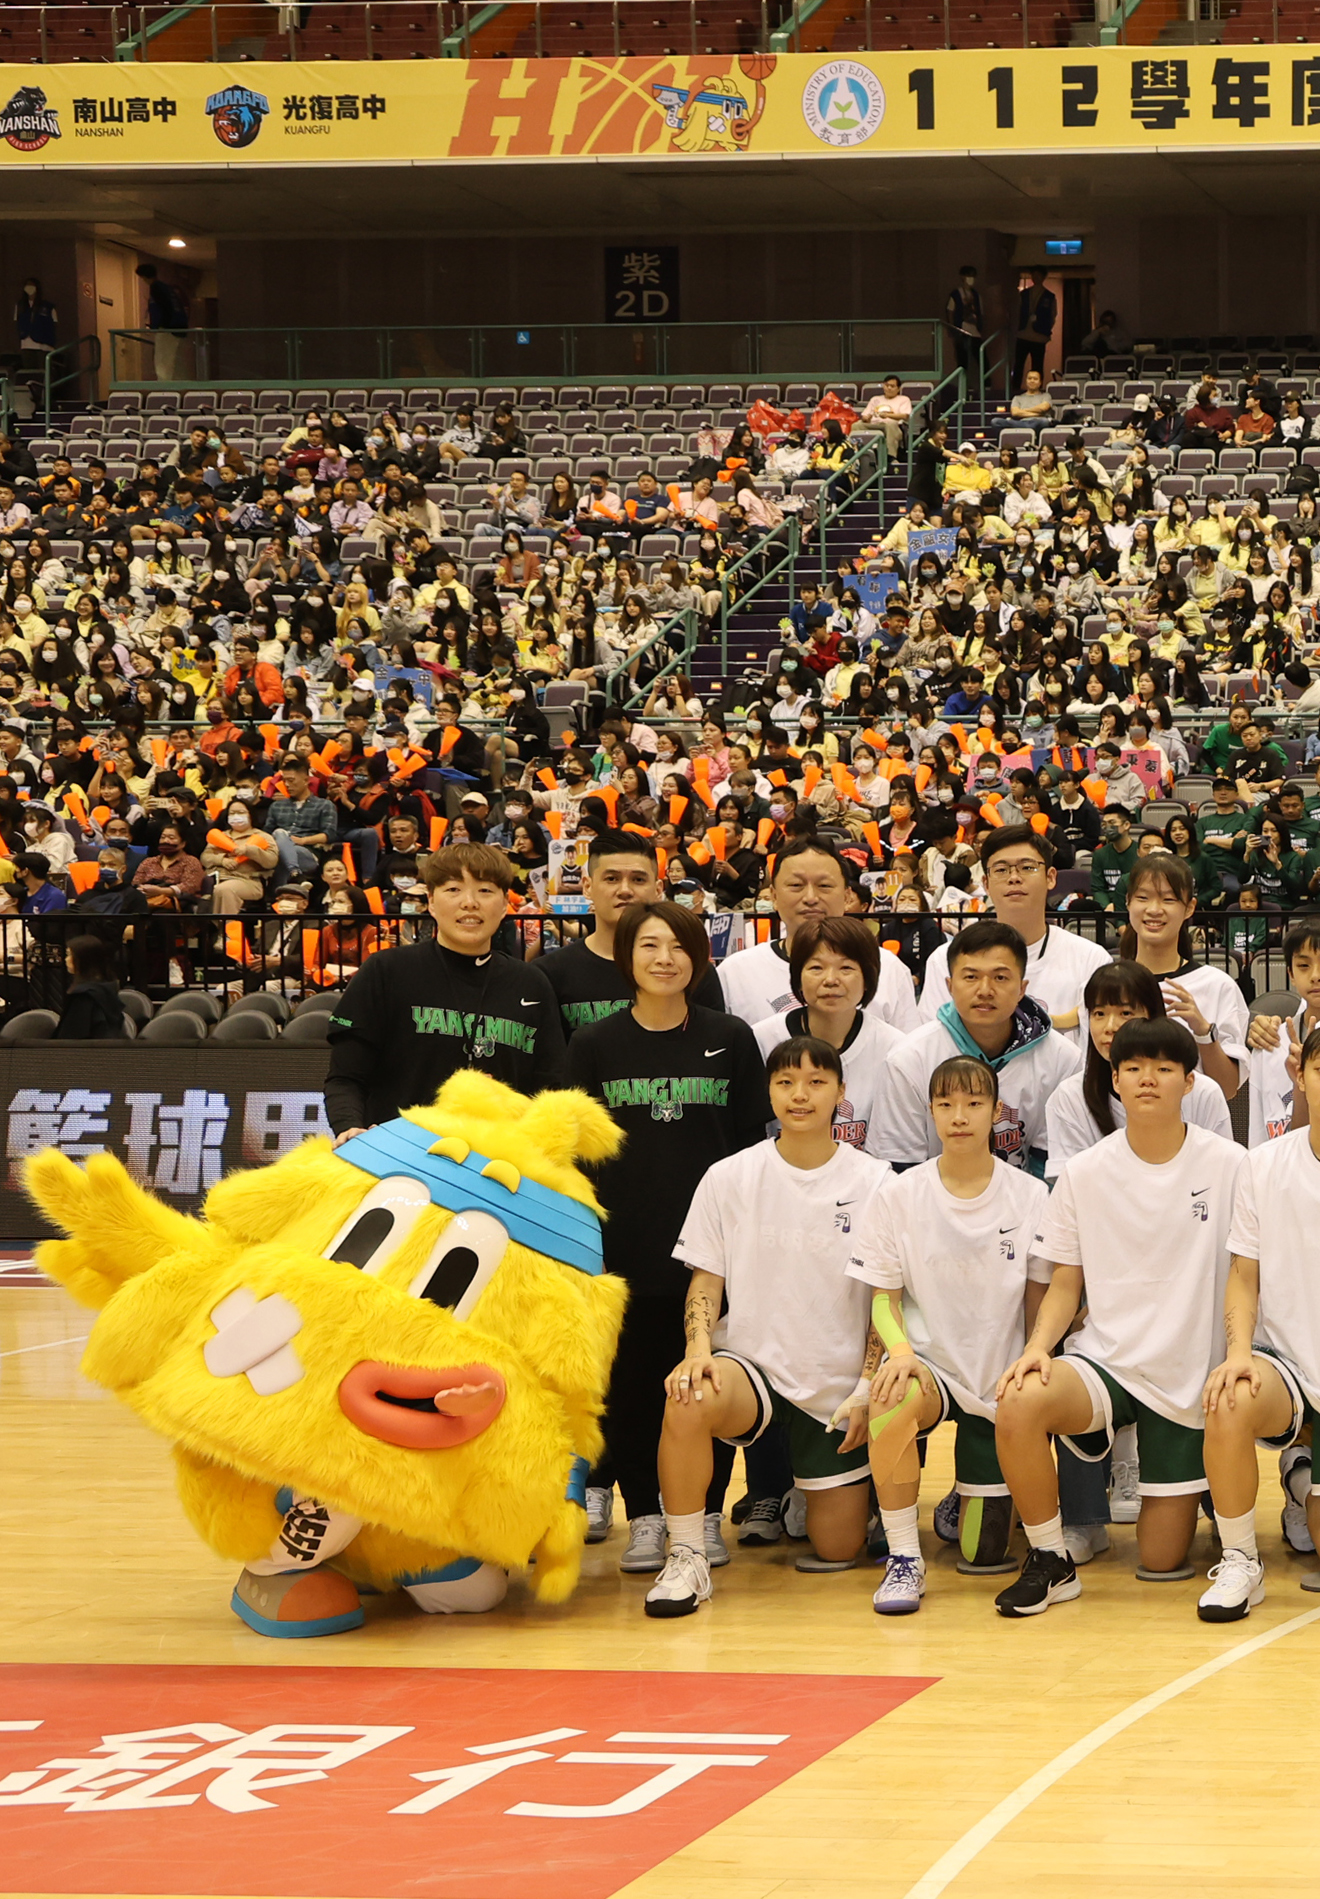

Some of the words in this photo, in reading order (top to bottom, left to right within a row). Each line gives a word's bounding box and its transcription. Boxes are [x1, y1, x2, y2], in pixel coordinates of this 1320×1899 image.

[283, 94, 387, 121] 光復高中
[804, 69, 828, 127] MINISTRY
[829, 63, 845, 75] OF
[848, 64, 881, 127] EDUCATION
[72, 97, 177, 124] 南山高中
[75, 128, 124, 138] NANSHAN
[284, 124, 331, 135] KUANGFU
[622, 252, 661, 285] 紫
[615, 290, 670, 316] 2D
[484, 1014, 537, 1054] MING
[601, 1077, 670, 1109] YANG
[671, 1076, 730, 1108] MING
[0, 1718, 792, 1818] 銀行
